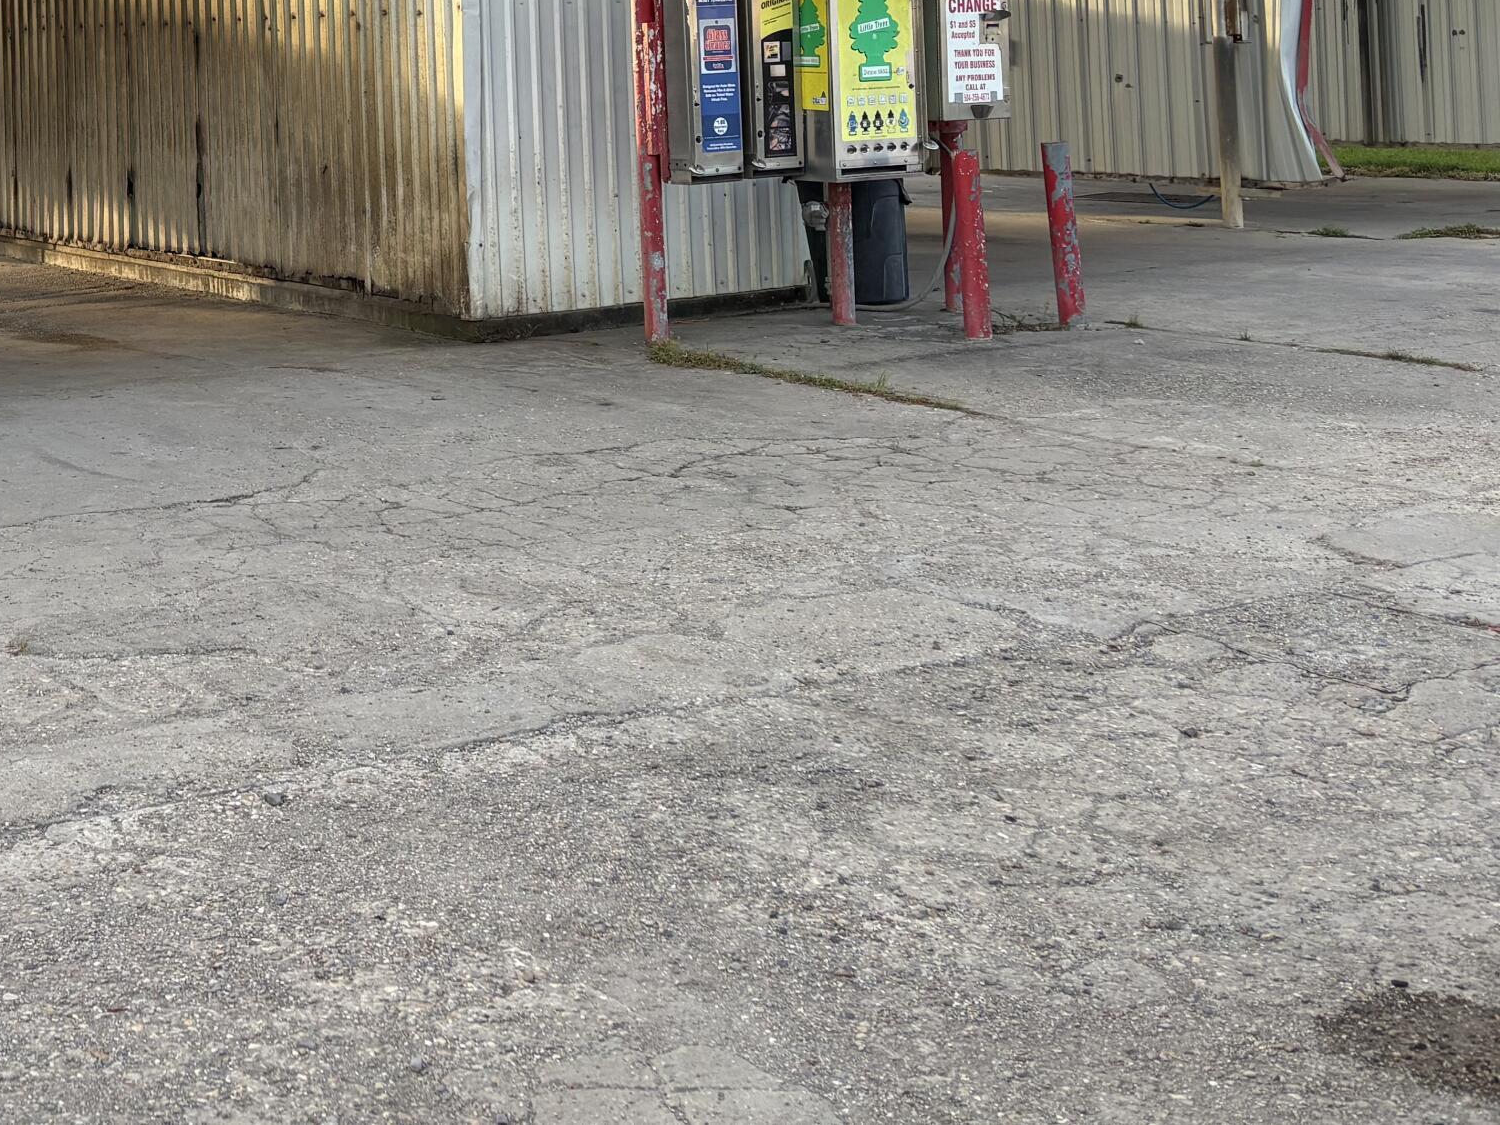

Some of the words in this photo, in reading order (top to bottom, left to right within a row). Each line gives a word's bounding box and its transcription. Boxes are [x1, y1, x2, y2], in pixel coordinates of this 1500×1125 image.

[706, 28, 728, 40] Glass
[951, 31, 975, 40] Accepted
[954, 49, 971, 57] THANK
[972, 49, 983, 57] YOU
[984, 48, 995, 56] FOR
[954, 61, 969, 69] YOUR
[969, 60, 995, 68] BUSINESS
[955, 74, 965, 82] ANY
[966, 73, 995, 81] PROBLEMS
